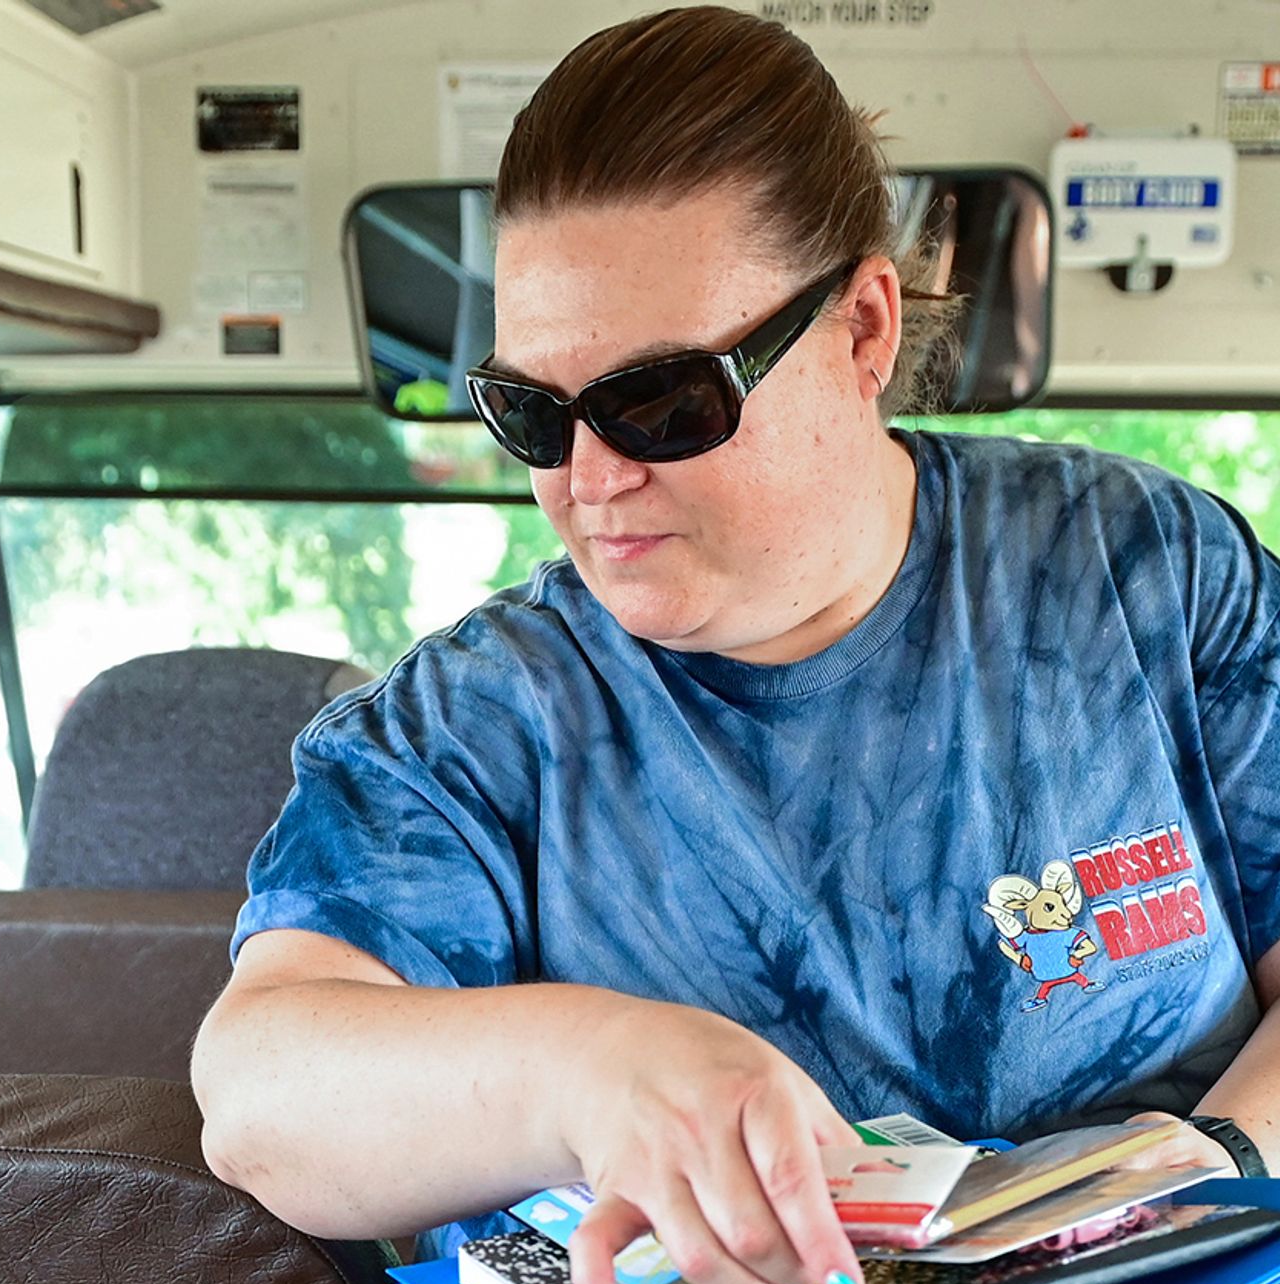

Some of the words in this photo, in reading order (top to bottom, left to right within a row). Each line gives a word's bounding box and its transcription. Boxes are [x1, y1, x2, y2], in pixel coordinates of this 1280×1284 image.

[887, 2, 931, 23] STEP
[1083, 178, 1138, 206] BODY
[1070, 820, 1193, 898] RUSSELL
[1091, 874, 1207, 961] RAMS
